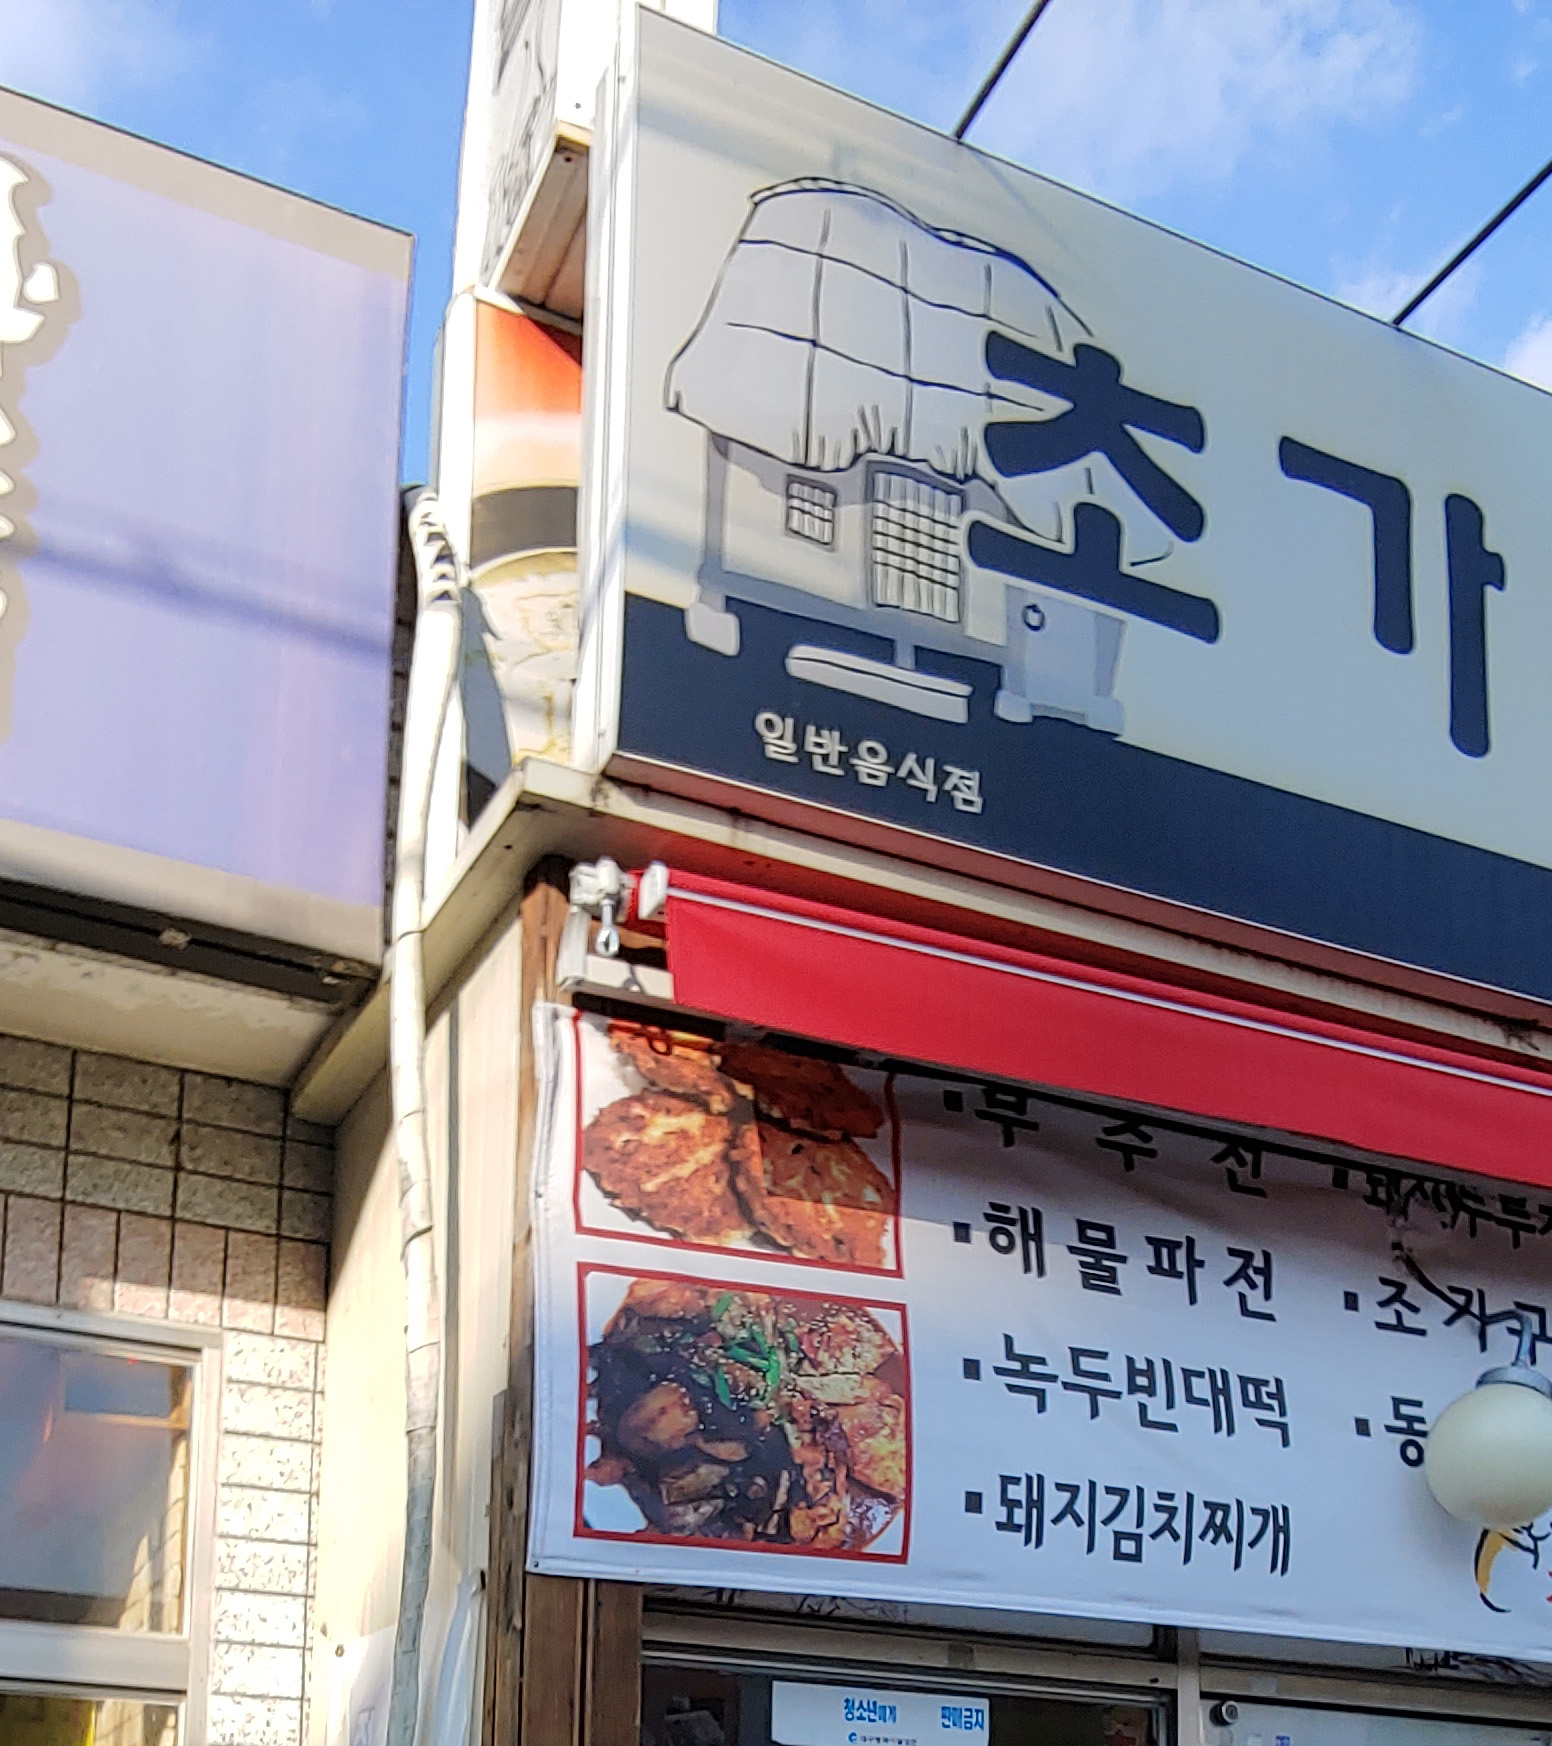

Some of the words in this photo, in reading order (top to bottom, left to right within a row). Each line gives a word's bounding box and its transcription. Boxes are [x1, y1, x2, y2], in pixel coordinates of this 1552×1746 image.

[754, 711, 985, 815] 일반음식점
[983, 1201, 1279, 1322] 해물파전
[992, 1332, 1292, 1448] 녹두빈대떡
[995, 1472, 1293, 1577] 돼지김치찌개
[940, 1705, 985, 1731] 판매금지
